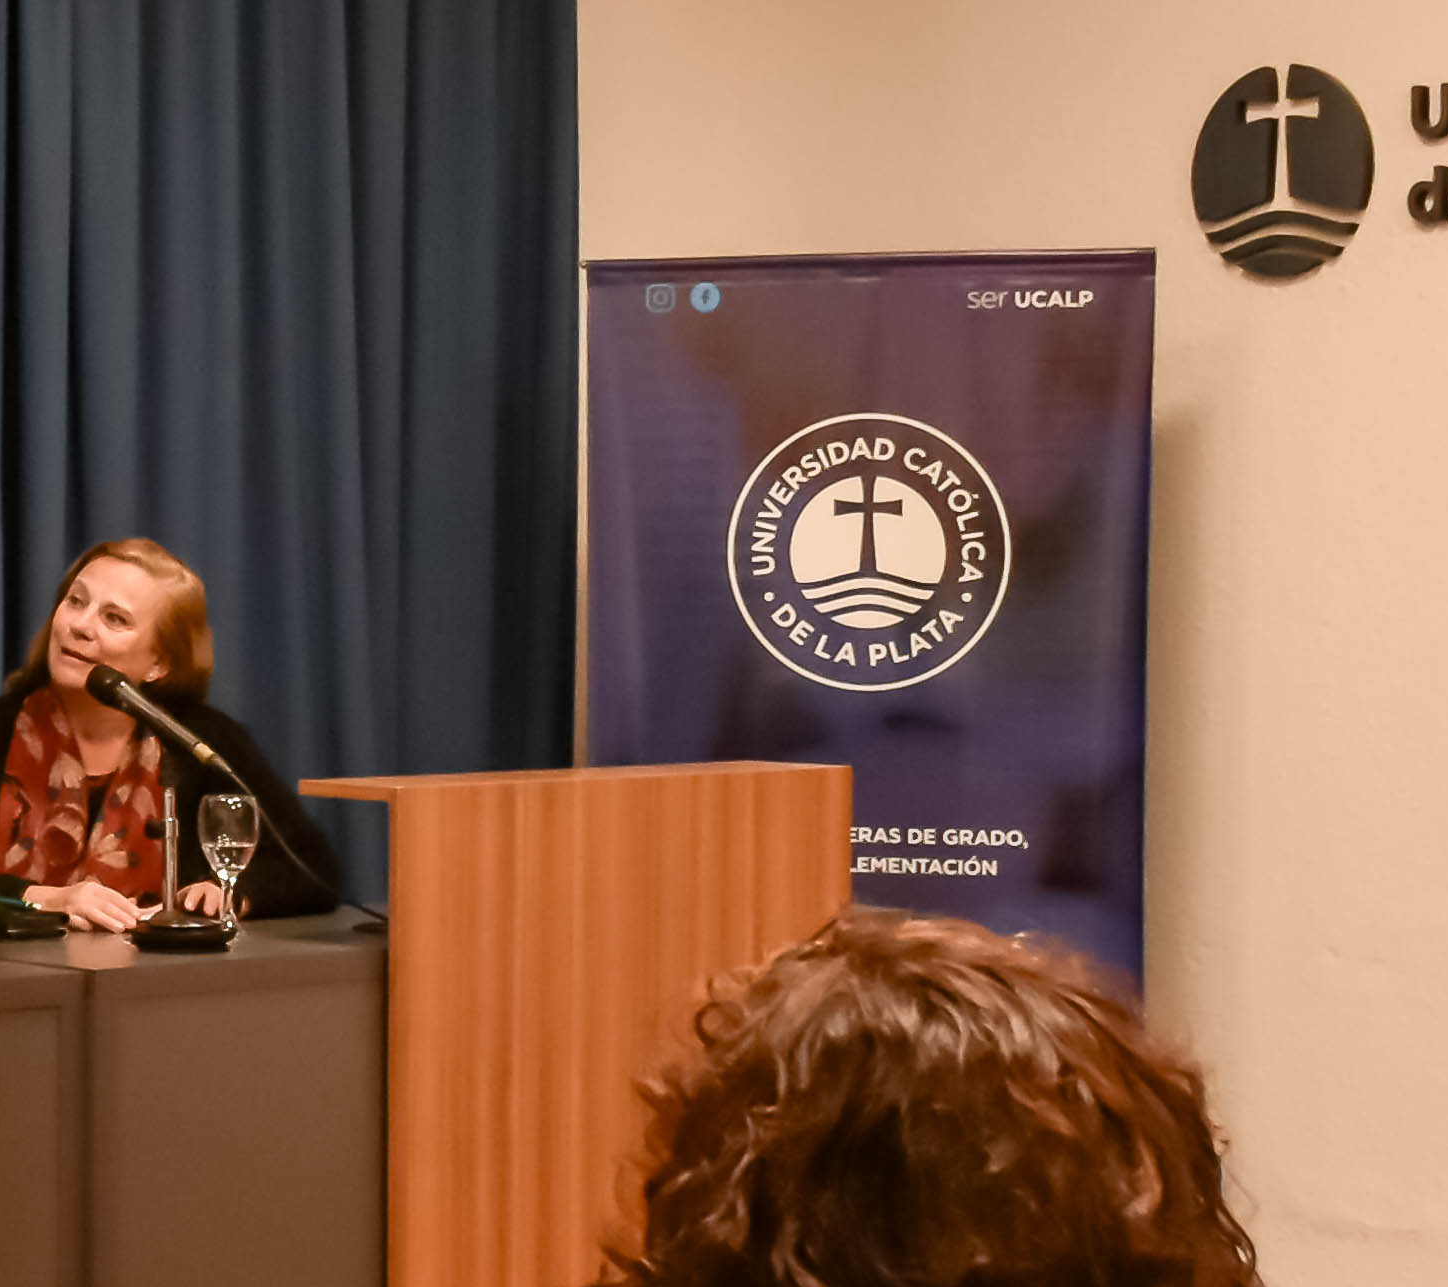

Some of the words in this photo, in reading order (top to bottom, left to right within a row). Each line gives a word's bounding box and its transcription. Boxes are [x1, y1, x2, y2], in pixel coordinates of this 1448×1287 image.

[967, 289, 1007, 310] ser
[1014, 288, 1095, 310] UCALP
[750, 436, 897, 578] UNIVERSIDAD
[902, 447, 987, 585] CATÓLICA
[770, 602, 810, 646] DE
[814, 634, 857, 667] LA
[868, 608, 965, 667] PLATA
[850, 826, 901, 845] ERAS
[907, 828, 936, 845] DE
